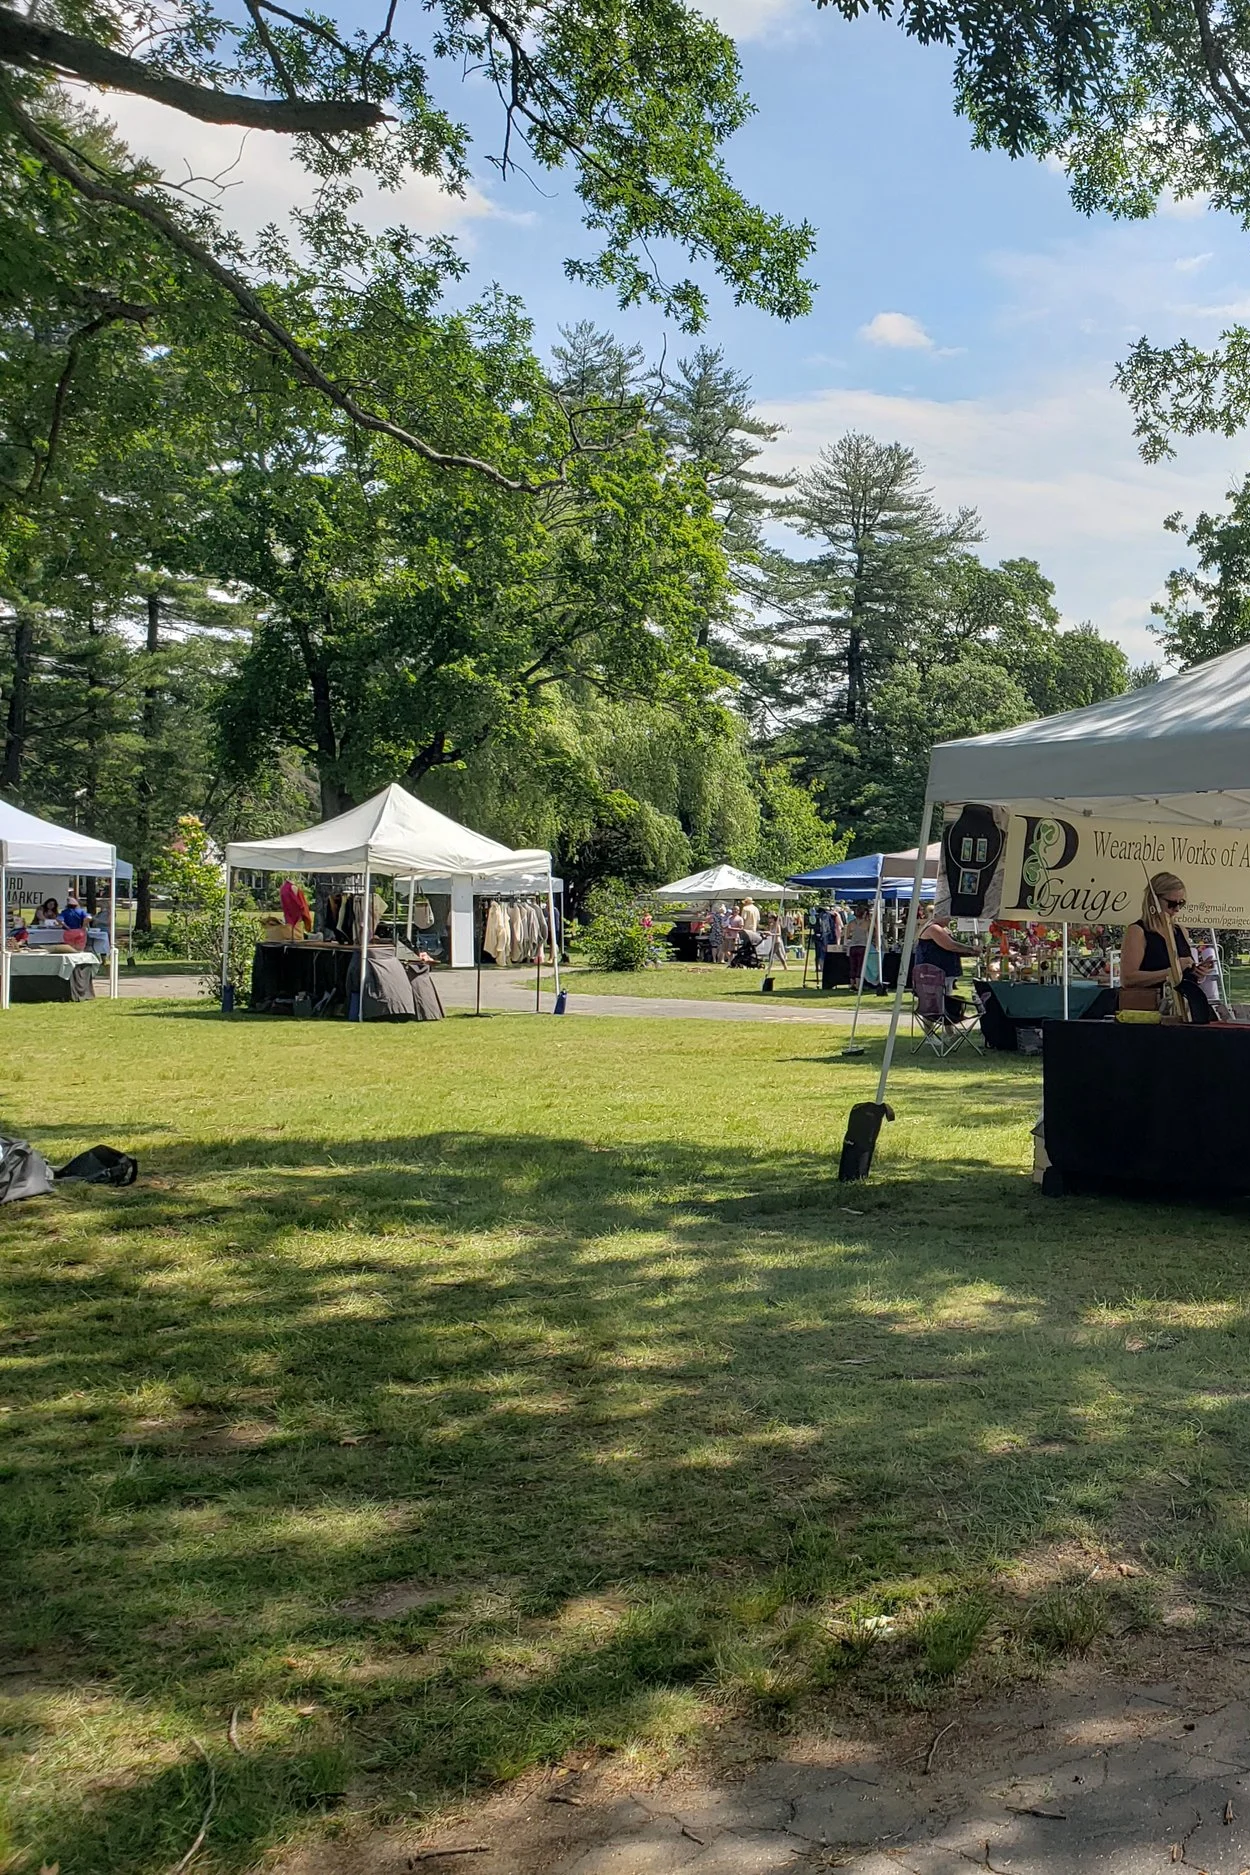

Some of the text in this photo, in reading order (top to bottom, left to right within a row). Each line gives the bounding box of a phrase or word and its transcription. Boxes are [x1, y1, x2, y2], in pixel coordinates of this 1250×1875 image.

[1093, 831, 1165, 862] Wearable
[1171, 837, 1216, 866] Works
[1220, 841, 1238, 867] of
[1182, 902, 1244, 913] sign@gmail.com
